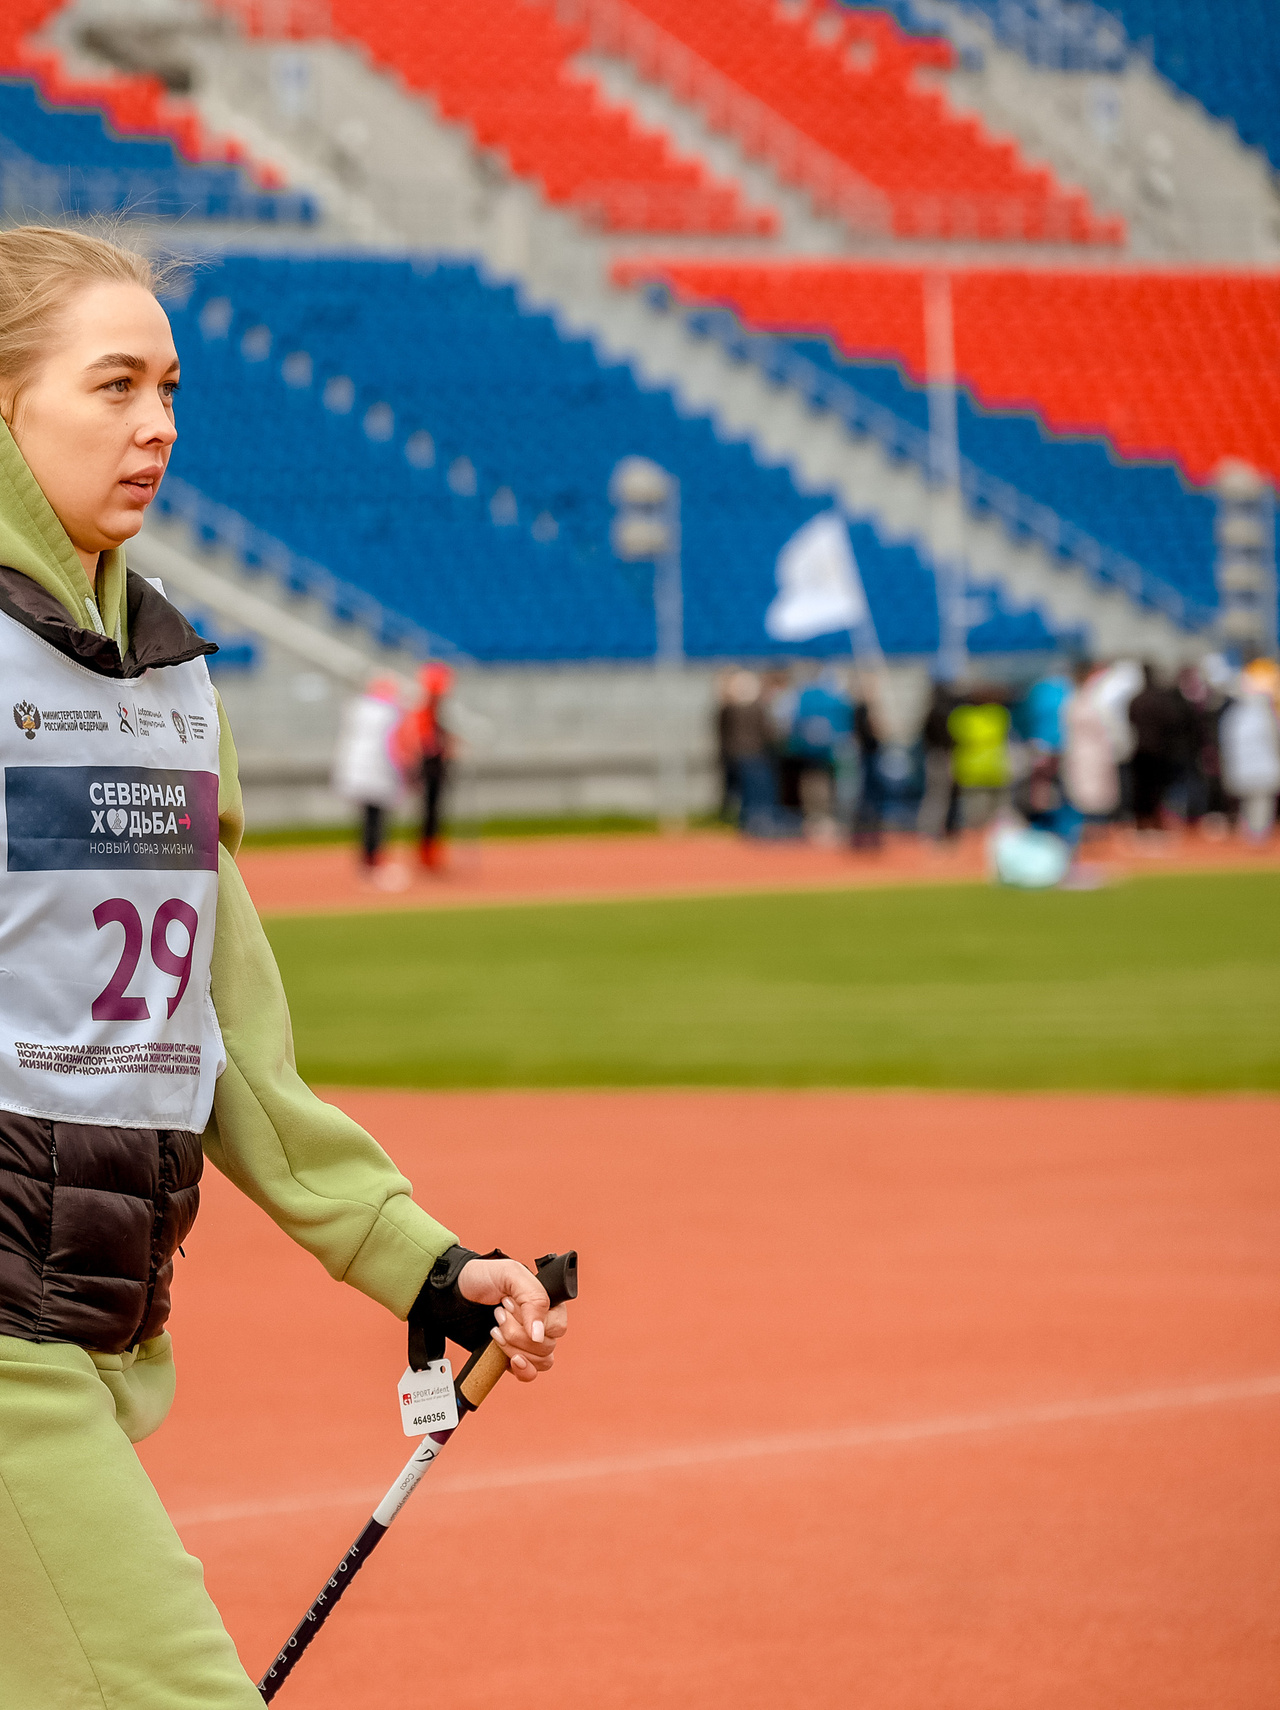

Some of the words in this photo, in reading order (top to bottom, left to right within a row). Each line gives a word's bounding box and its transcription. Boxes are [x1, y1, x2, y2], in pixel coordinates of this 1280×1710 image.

[41, 710, 83, 720] МИНИСТЕРСТВО
[83, 710, 102, 720] СПОРТА
[43, 720, 78, 731] РОССИЙСКОЙ
[79, 721, 109, 732] ФЕДЕРАЦИИ
[89, 782, 187, 807] СЕВЕРНАЯ
[89, 840, 131, 854] НОВЫЙ
[133, 843, 159, 855] ОБРАЗ
[161, 843, 194, 855] ЖИЗНИ
[91, 897, 199, 1021] 29
[17, 1049, 53, 1061] НОРМА
[54, 1052, 83, 1065] ЖИЗНИ
[83, 1056, 107, 1066] СПОРТ
[113, 1052, 149, 1064] НОРМА
[111, 1043, 141, 1055] СПОРТ
[18, 1058, 53, 1071] ЖИЗНИ
[53, 1062, 77, 1075] СПОРТ
[83, 1065, 117, 1076] НОРМА
[118, 1063, 149, 1074] ЖИЗНИ
[413, 1411, 446, 1426] 4649356
[400, 1473, 415, 1490] Союз
[306, 1545, 360, 1622] НОВЫЙ
